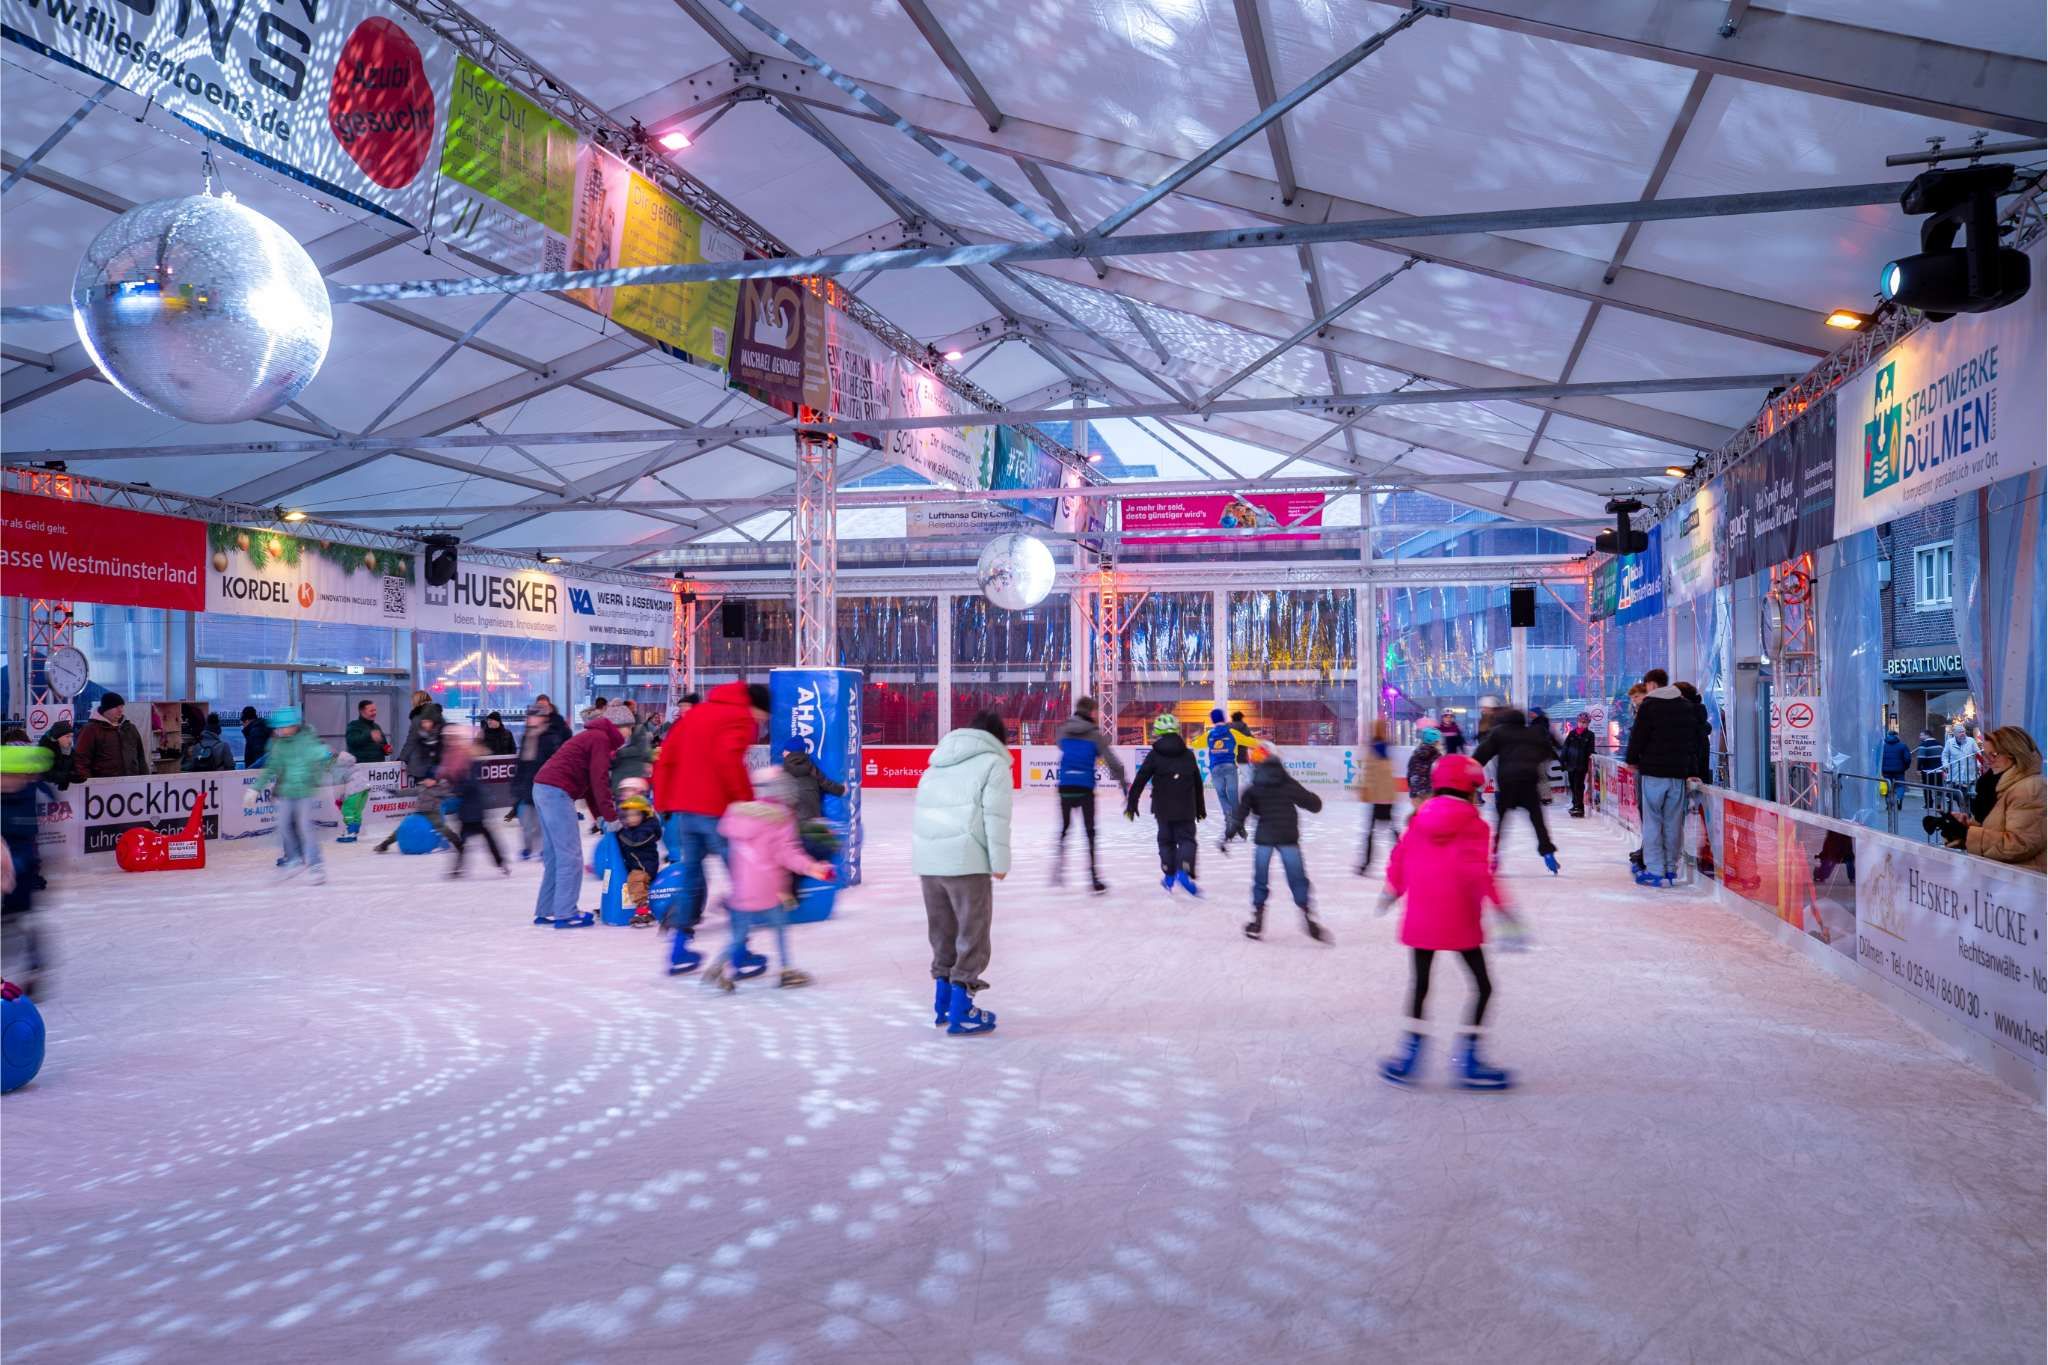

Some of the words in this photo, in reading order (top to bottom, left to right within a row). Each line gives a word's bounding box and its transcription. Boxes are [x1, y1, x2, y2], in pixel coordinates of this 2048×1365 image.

[28, 0, 291, 141] w.fliesentoens.de
[352, 59, 409, 89] Azubi
[461, 69, 494, 116] Hey
[500, 95, 526, 133] Du!
[336, 102, 430, 143] gesucht
[634, 186, 649, 209] Dir
[741, 349, 771, 372] MICHAEL
[1905, 345, 1999, 426] STADTWERKE
[1903, 391, 1990, 480] DÜLMEN
[1934, 461, 1969, 493] persönlich
[1971, 460, 1984, 475] vor
[1985, 452, 1999, 469] Ort
[928, 511, 969, 519] Lufthansa
[971, 510, 988, 520] City
[1125, 504, 1135, 512] Je
[1136, 503, 1155, 512] mehr
[1156, 503, 1167, 511] ihr
[1125, 511, 1146, 520] desto
[1147, 510, 1182, 521] günstiger
[10, 518, 23, 529] als
[25, 520, 45, 532] Geld
[49, 550, 198, 585] Westmünsterland
[222, 575, 289, 604] KORDEL
[320, 593, 351, 603] INNOVATION
[352, 596, 377, 606] INCLUDED
[454, 572, 557, 615] HUESKER
[368, 768, 400, 783] Handy
[883, 767, 924, 777] Sparkass
[373, 801, 397, 813] EXPRESS
[90, 830, 123, 848] uhre
[1909, 868, 1959, 920] HESKER
[1974, 889, 2027, 946] LÜCKE
[1859, 935, 1884, 964] Dülmen
[1959, 936, 2021, 982] Rechtsanwälte
